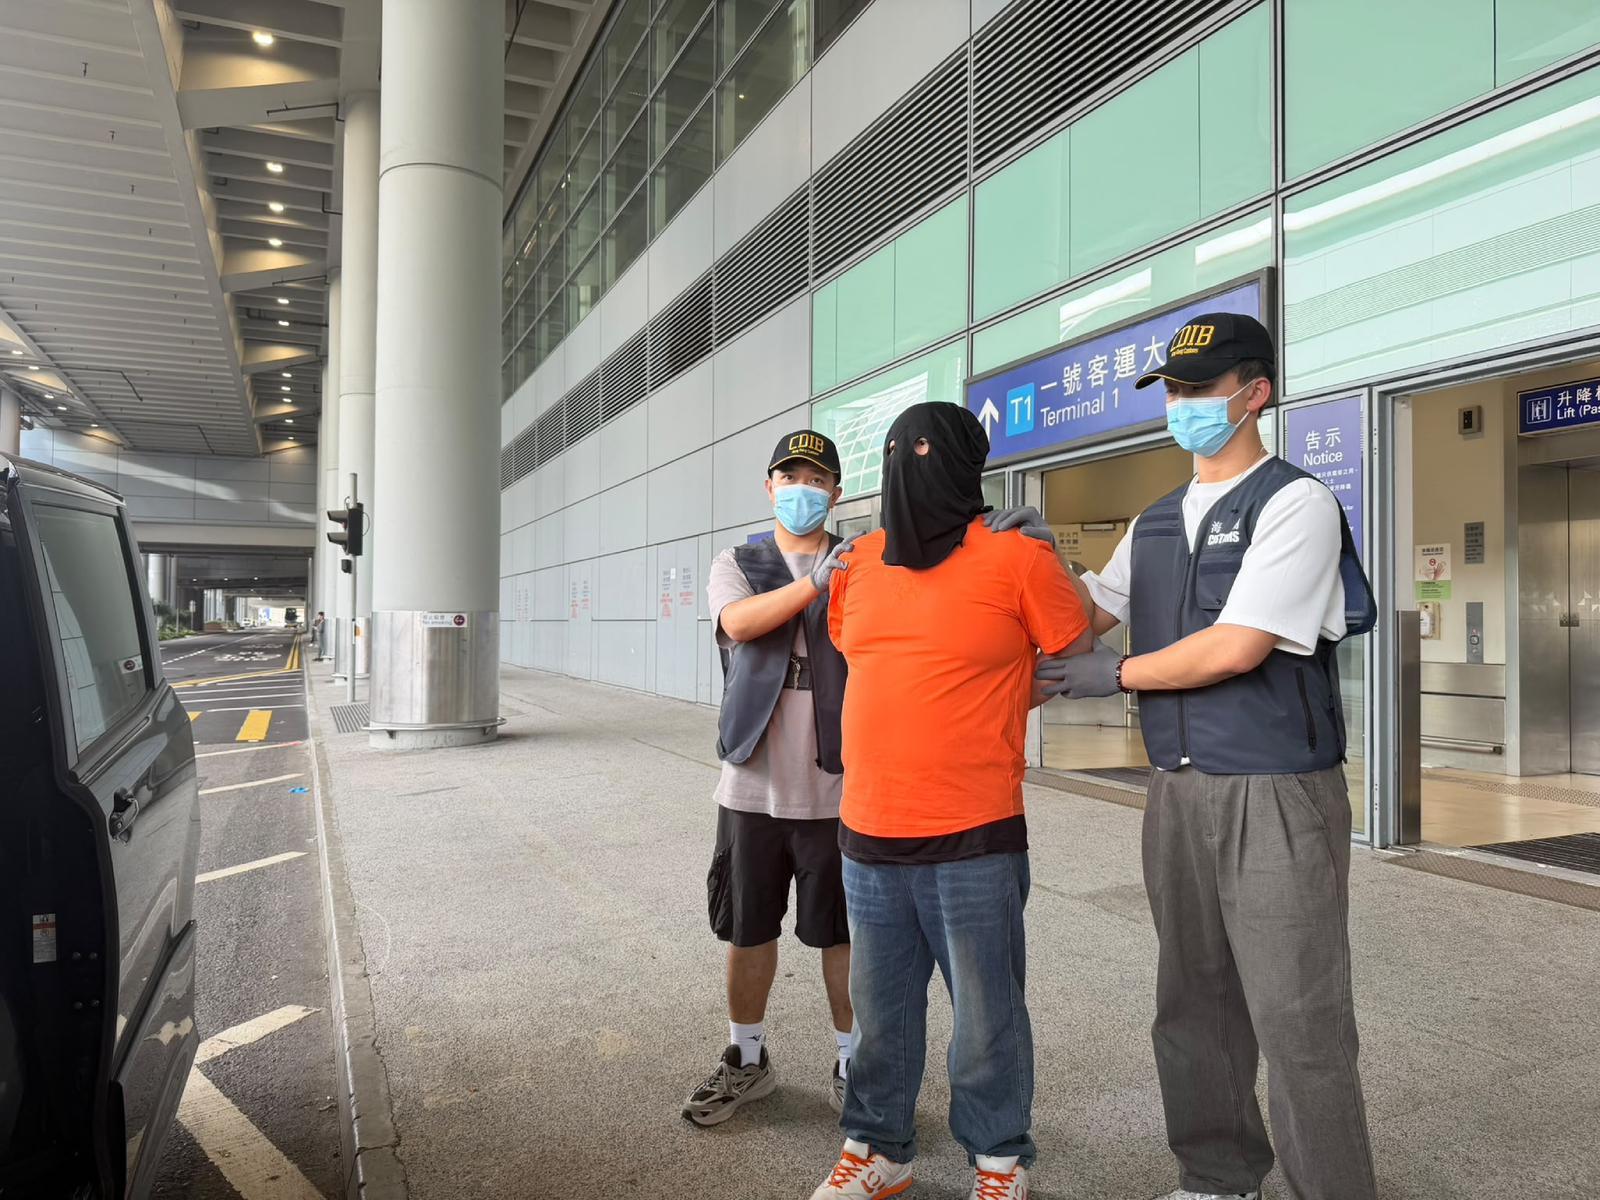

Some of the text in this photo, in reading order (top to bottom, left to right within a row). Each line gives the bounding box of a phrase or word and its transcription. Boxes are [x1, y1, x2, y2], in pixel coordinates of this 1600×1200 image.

[1040, 329, 1179, 396] 一號客運大
[1011, 395, 1031, 425] T1
[1040, 388, 1119, 428] Terminal 1
[1557, 407, 1575, 420] Lift
[789, 433, 824, 453] CDIB
[1305, 427, 1341, 451] 告示
[1303, 450, 1343, 467] Notice
